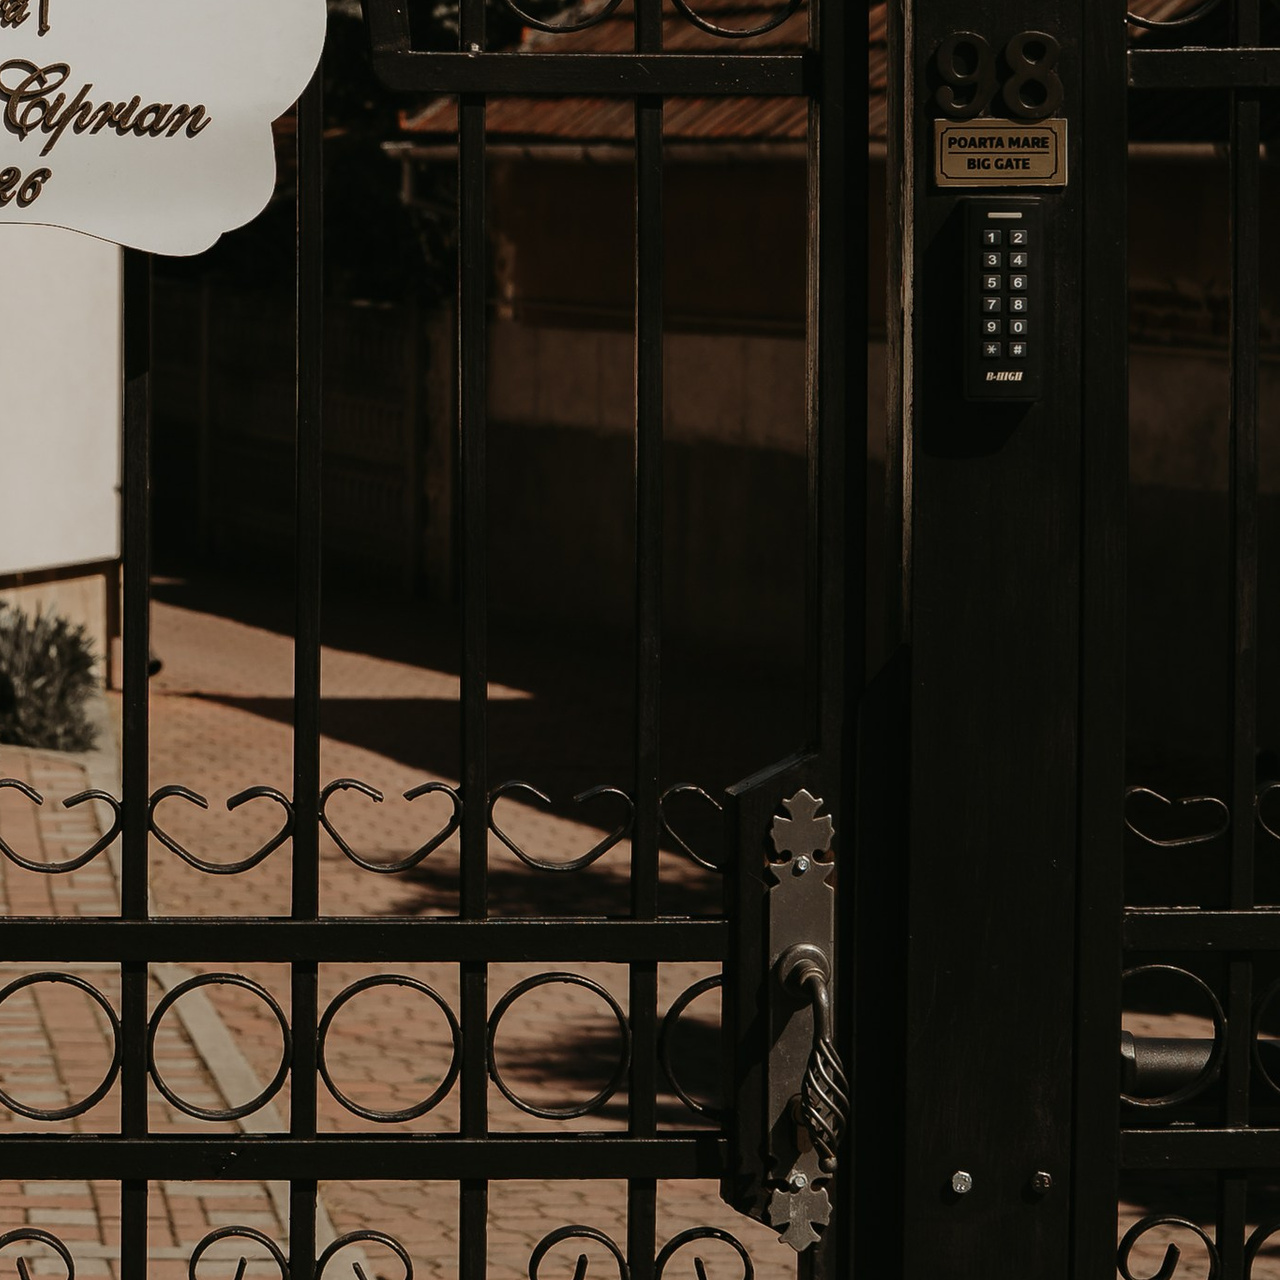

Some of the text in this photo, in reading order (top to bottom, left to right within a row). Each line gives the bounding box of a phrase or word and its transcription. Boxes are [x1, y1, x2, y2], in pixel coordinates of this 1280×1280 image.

[930, 30, 1065, 121] 98
[948, 136, 1050, 149] POARTA MARE
[967, 158, 1030, 170] BIG GATE
[987, 232, 1023, 243] 1 2
[988, 255, 1022, 265] 3 4
[987, 277, 1023, 288] 5 6
[987, 299, 1023, 310] 7 8
[987, 322, 1023, 333] 9 0
[985, 371, 1023, 381] B-HIGH
